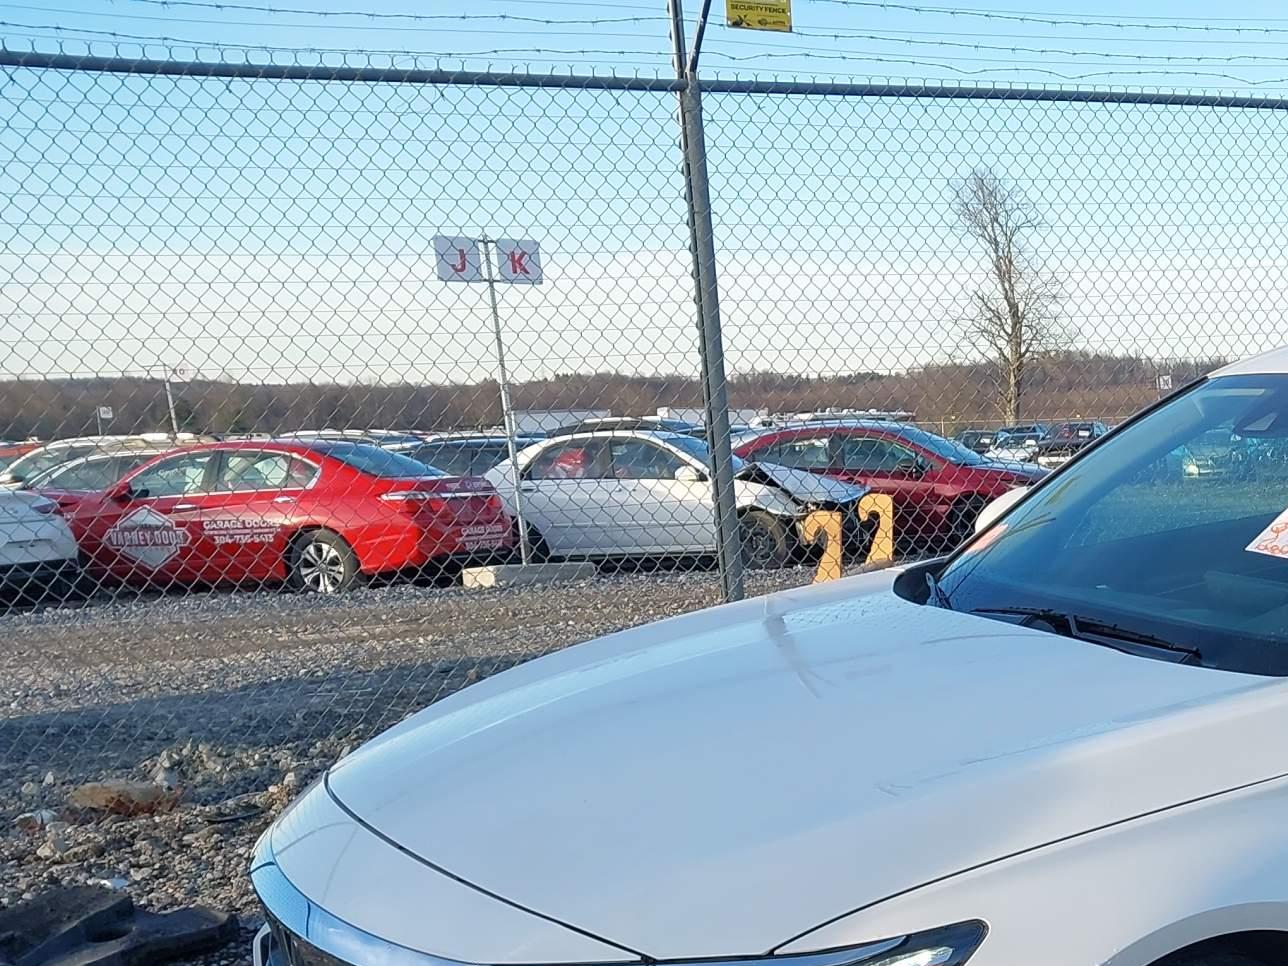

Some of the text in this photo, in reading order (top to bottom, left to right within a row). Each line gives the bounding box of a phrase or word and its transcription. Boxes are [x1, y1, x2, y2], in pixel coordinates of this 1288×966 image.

[451, 248, 466, 273] J
[511, 250, 530, 274] K
[203, 520, 243, 530] GARAGE
